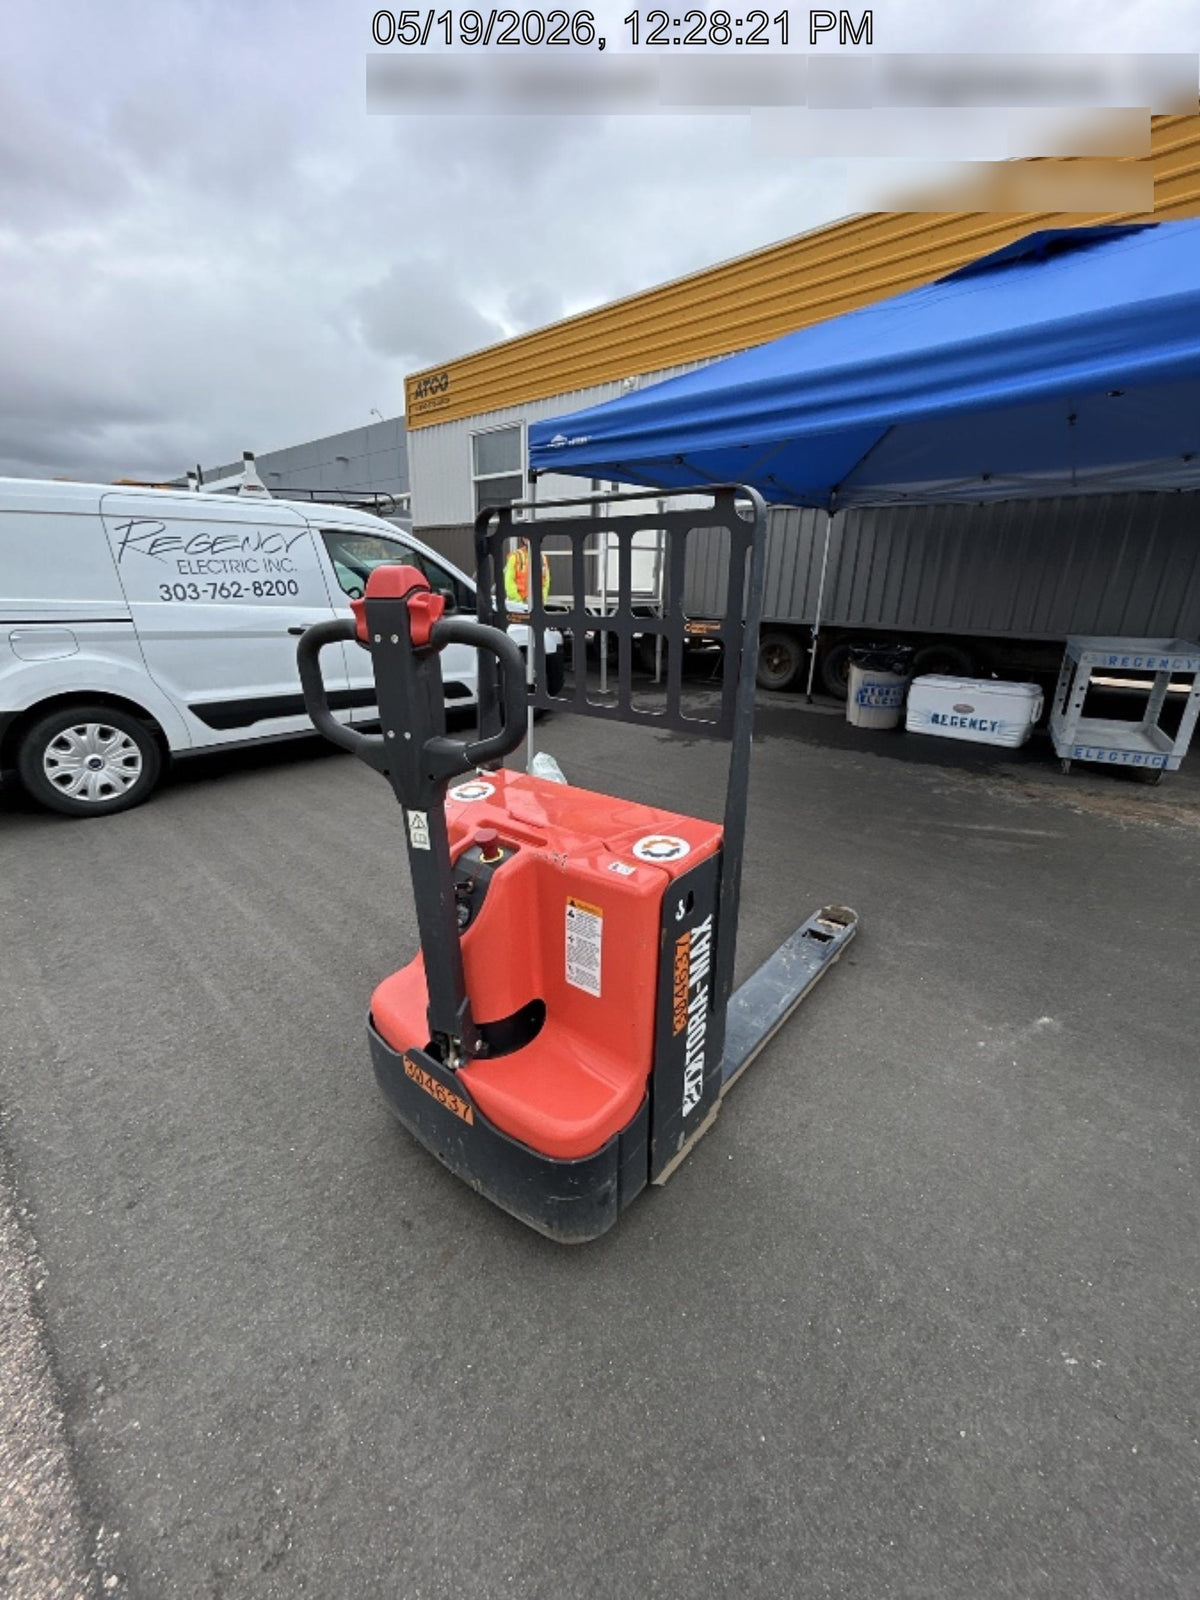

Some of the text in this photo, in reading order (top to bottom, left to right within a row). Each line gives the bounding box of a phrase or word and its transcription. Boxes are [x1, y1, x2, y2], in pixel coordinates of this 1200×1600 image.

[114, 520, 308, 564] REGENCY
[177, 557, 298, 575] ELECTRIC INC.
[159, 579, 299, 601] 303-762-8200
[1108, 655, 1193, 670] REGENCY
[930, 713, 998, 732] REGENCY
[1074, 747, 1163, 768] ELECTRIC
[685, 914, 713, 1066] TORA-MAX
